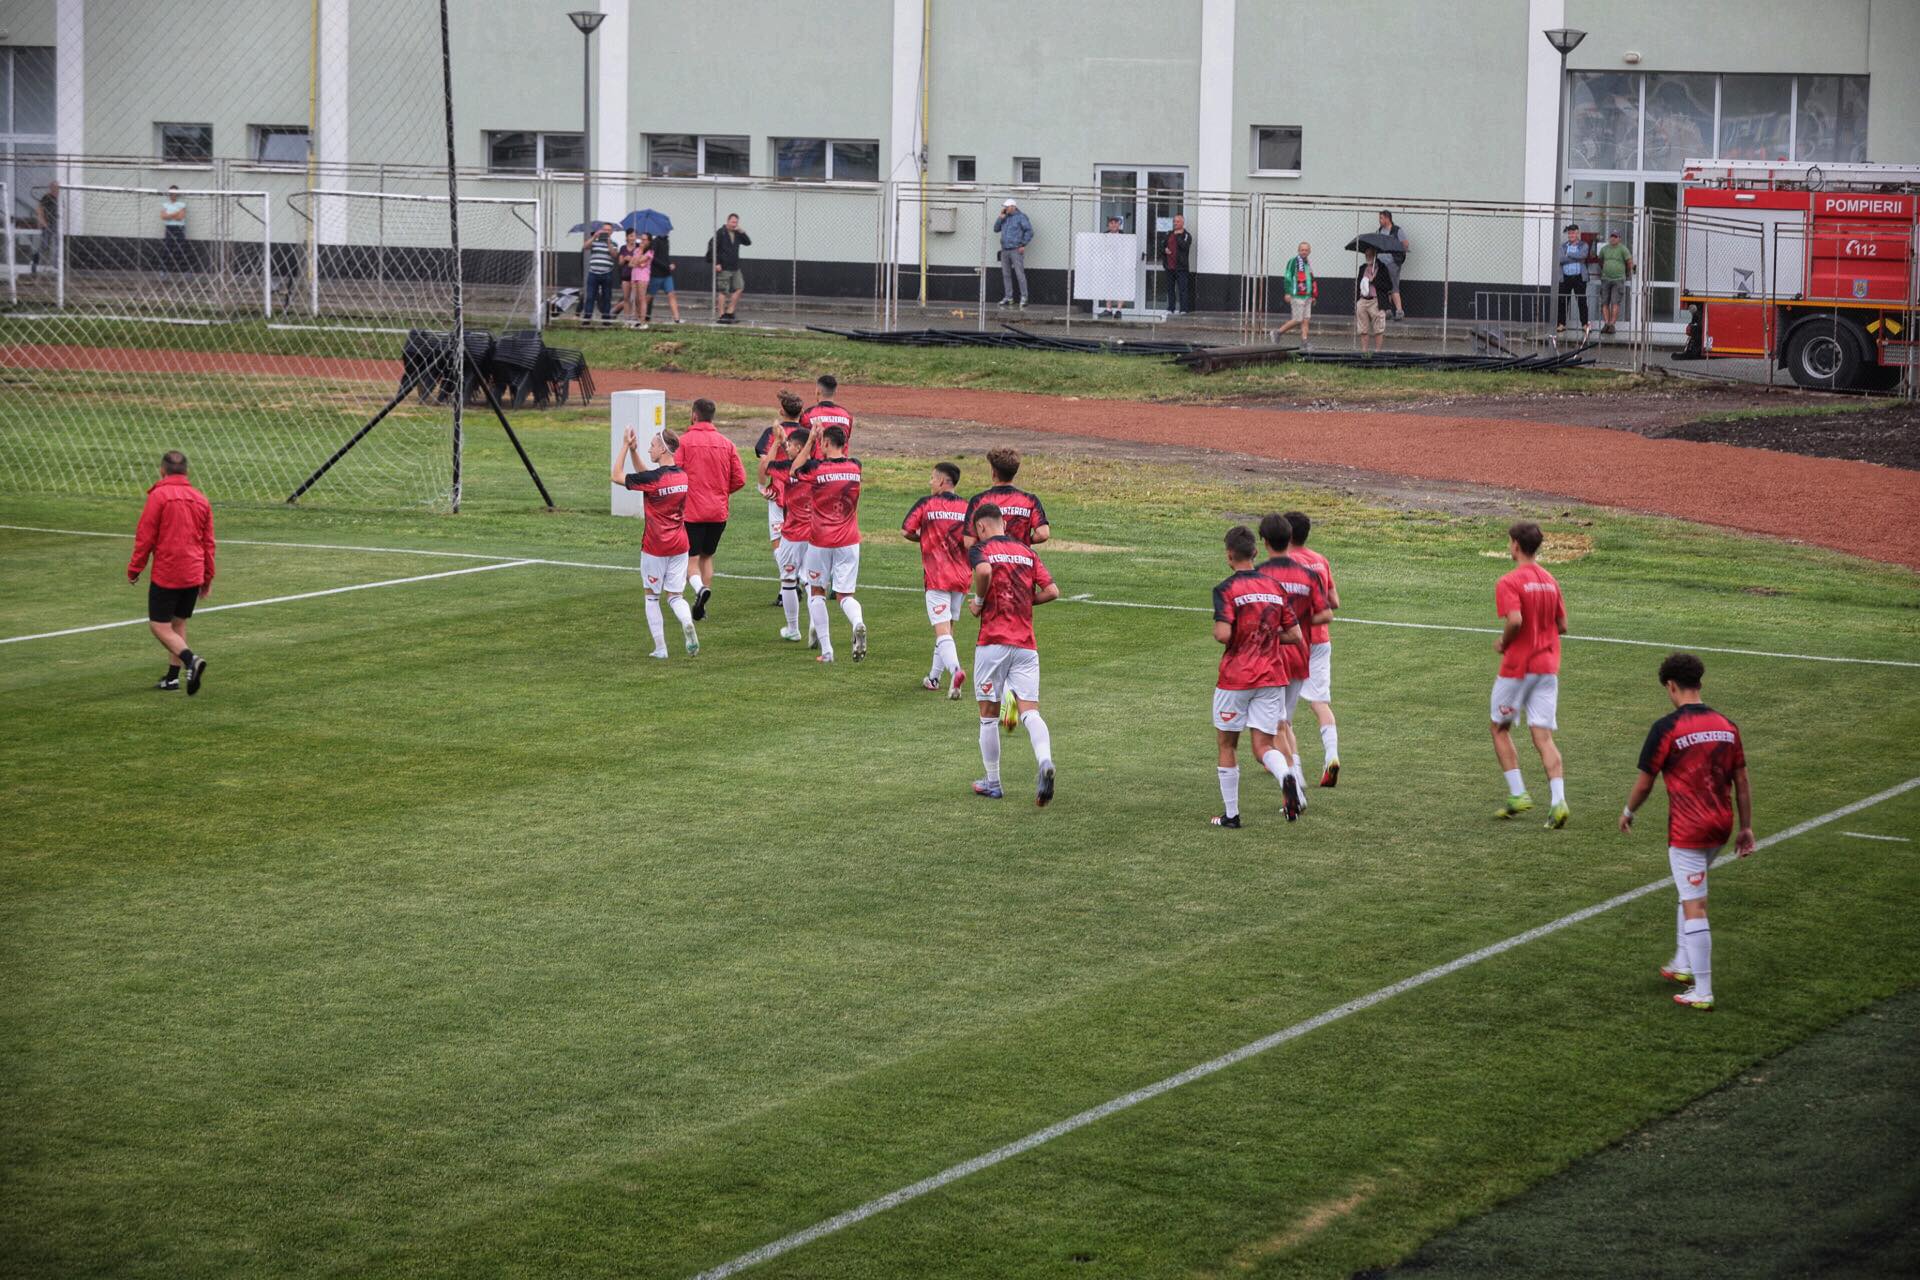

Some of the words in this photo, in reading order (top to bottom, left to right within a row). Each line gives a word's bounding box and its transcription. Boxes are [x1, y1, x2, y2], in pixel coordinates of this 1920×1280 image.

[1826, 199, 1902, 214] POMPIERII
[1854, 243, 1876, 256] 112
[817, 474, 826, 484] FK
[658, 486, 668, 497] FK
[928, 511, 935, 520] FK
[935, 511, 965, 521] CSIKSZERE
[1675, 736, 1689, 750] FK
